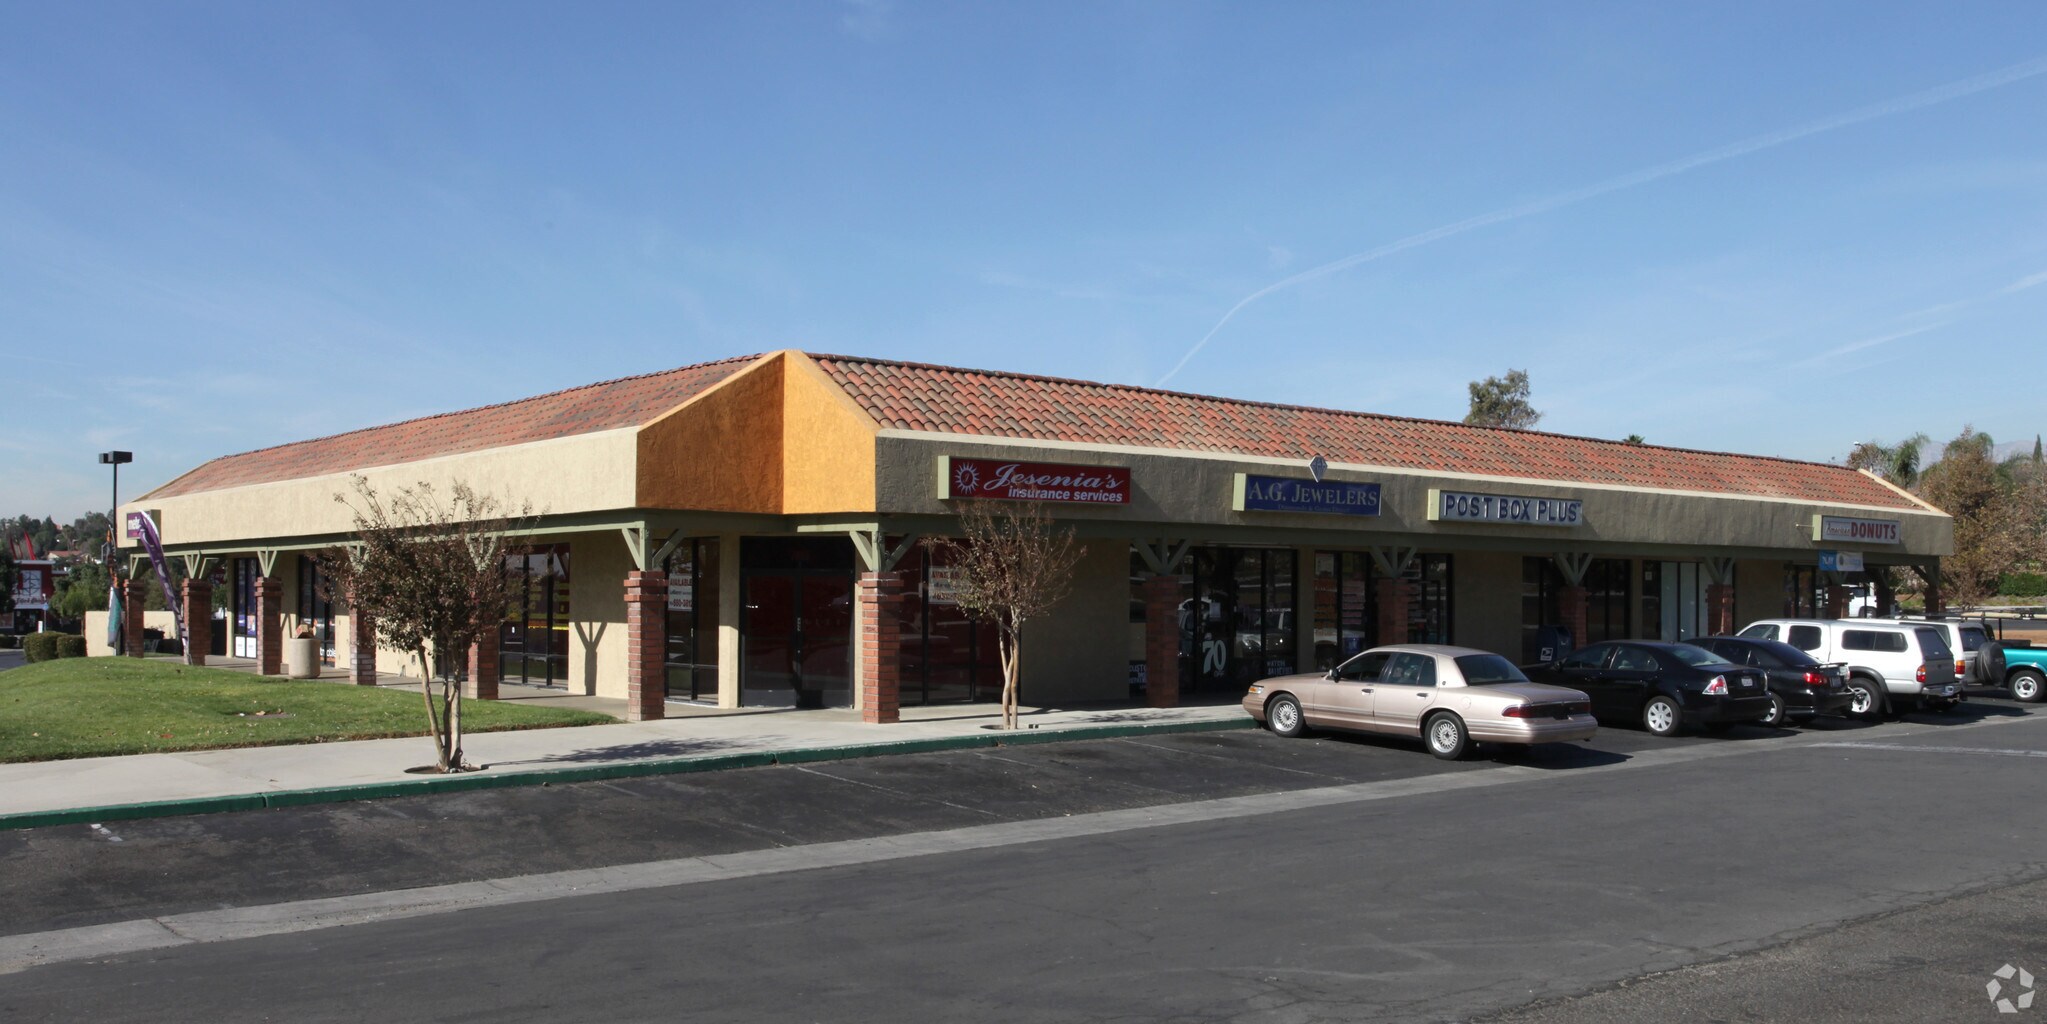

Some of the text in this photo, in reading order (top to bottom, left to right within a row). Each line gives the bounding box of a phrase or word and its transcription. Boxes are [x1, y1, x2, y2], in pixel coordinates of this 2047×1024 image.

[984, 463, 1124, 491] Jesenia's
[1008, 486, 1122, 502] insurance services
[1249, 481, 1377, 506] A.G. JEWELERS
[1444, 494, 1493, 518] POST
[1498, 499, 1530, 520] BOX
[1850, 521, 1897, 540] DONUTS
[1202, 640, 1227, 674] 70
